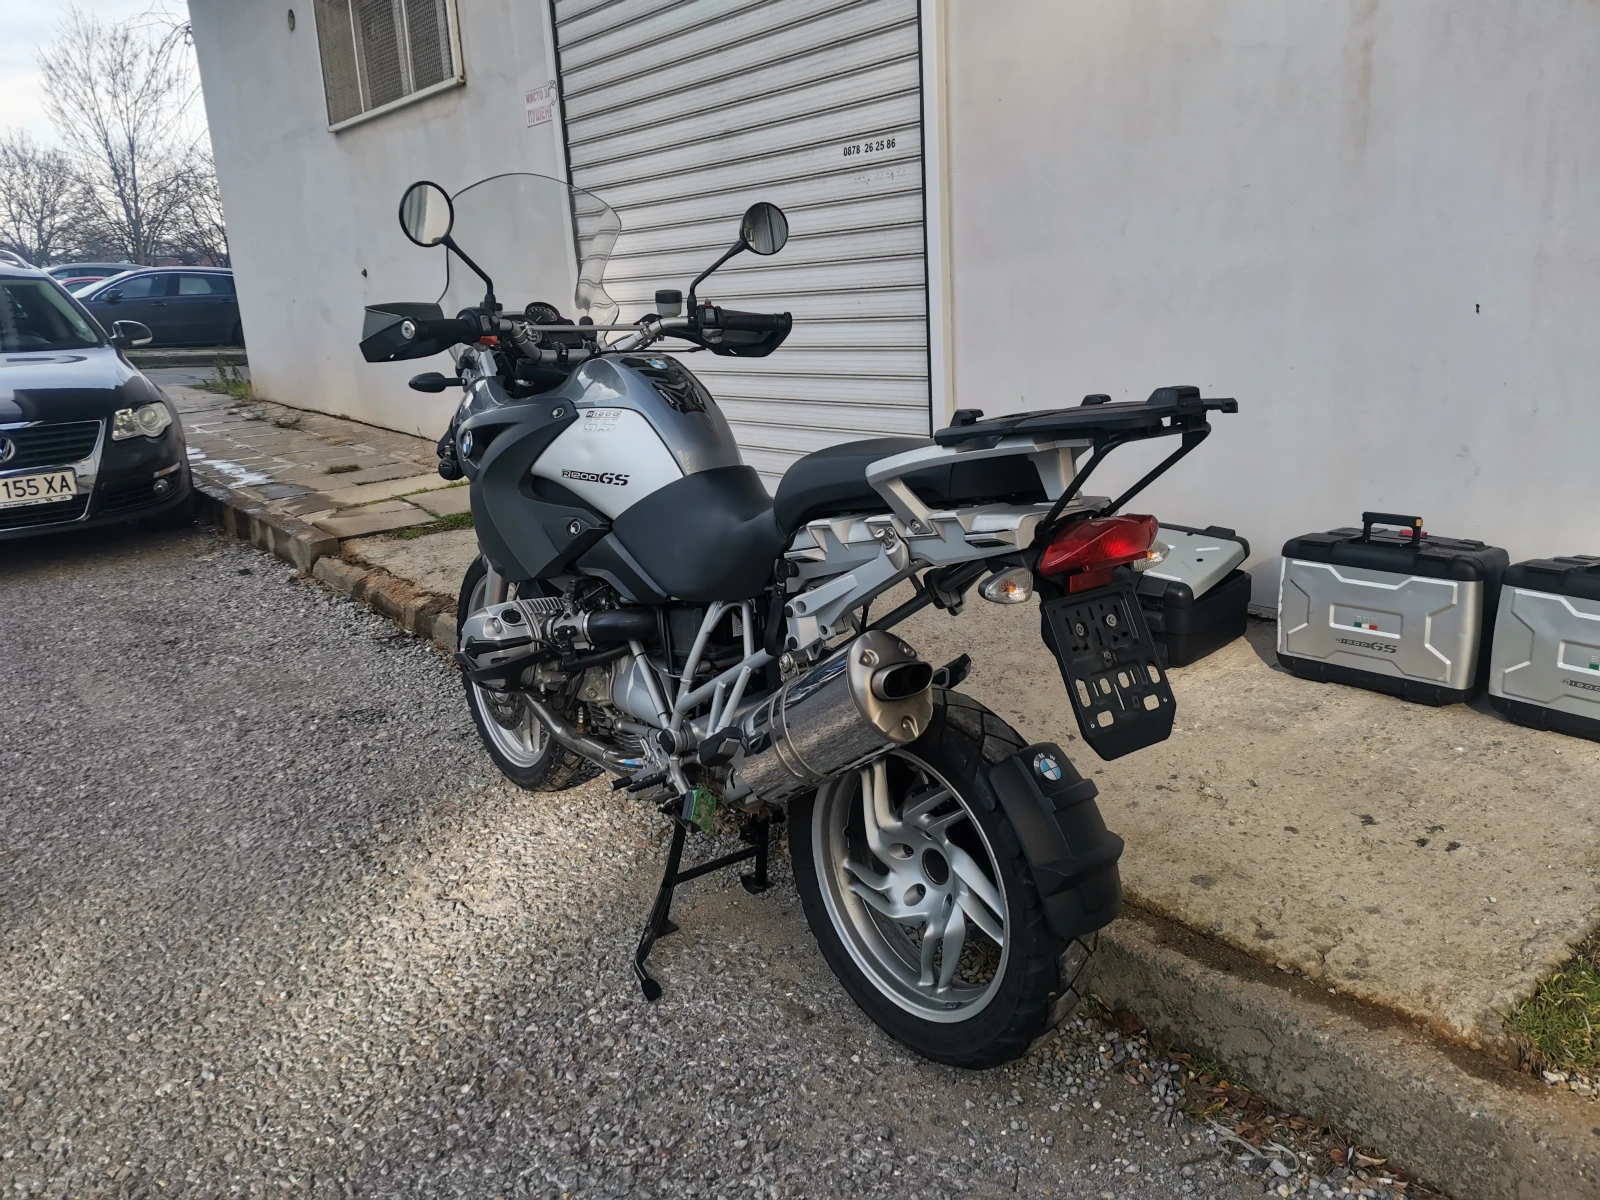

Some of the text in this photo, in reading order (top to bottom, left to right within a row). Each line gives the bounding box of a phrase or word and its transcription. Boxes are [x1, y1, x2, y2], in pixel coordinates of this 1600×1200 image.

[843, 138, 896, 157] 0878 26 25 86
[585, 410, 622, 418] R1200
[582, 418, 618, 432] GS
[1, 478, 40, 499] 155
